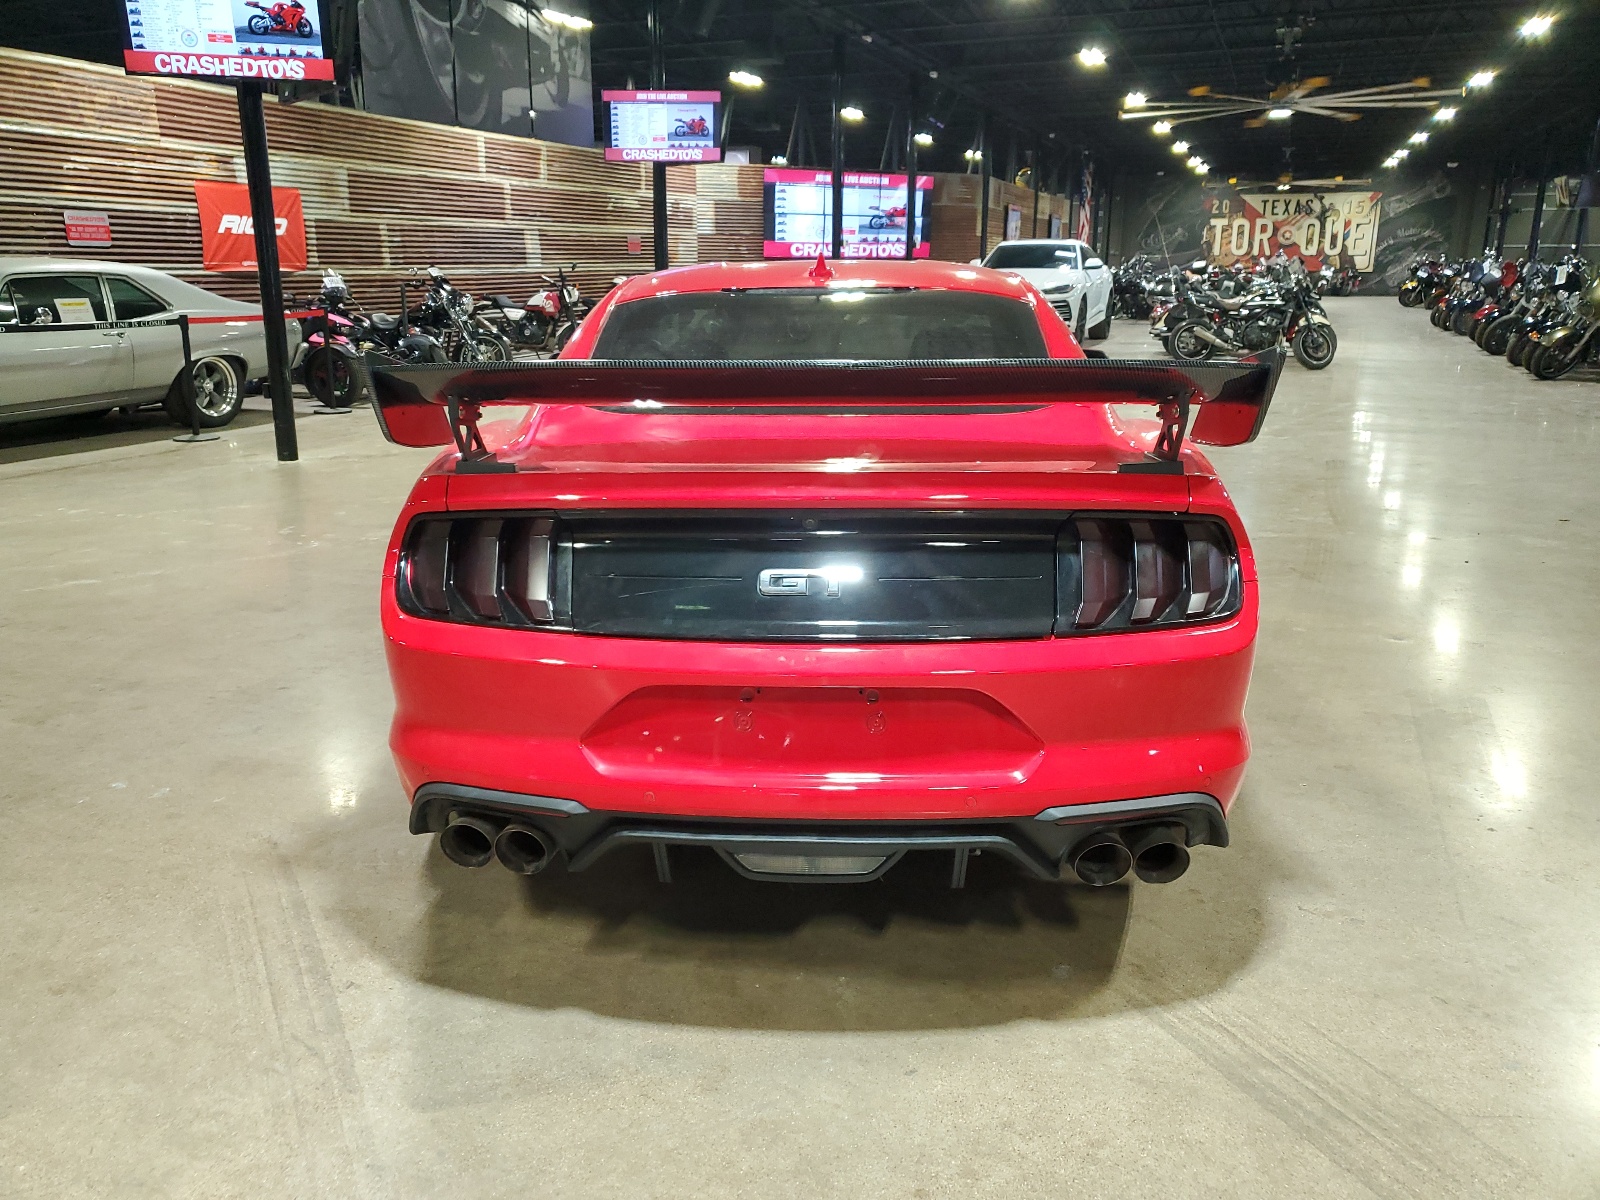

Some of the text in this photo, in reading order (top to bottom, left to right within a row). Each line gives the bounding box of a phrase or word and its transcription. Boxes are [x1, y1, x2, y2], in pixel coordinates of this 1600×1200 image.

[154, 54, 305, 79] CRASHEDTOYS
[622, 149, 704, 160] CRASHEDTOYS
[1211, 199, 1365, 216] 20 TEXAS 15
[94, 322, 111, 330] THIS
[113, 321, 129, 329] LINE
[140, 319, 167, 328] CLOSED
